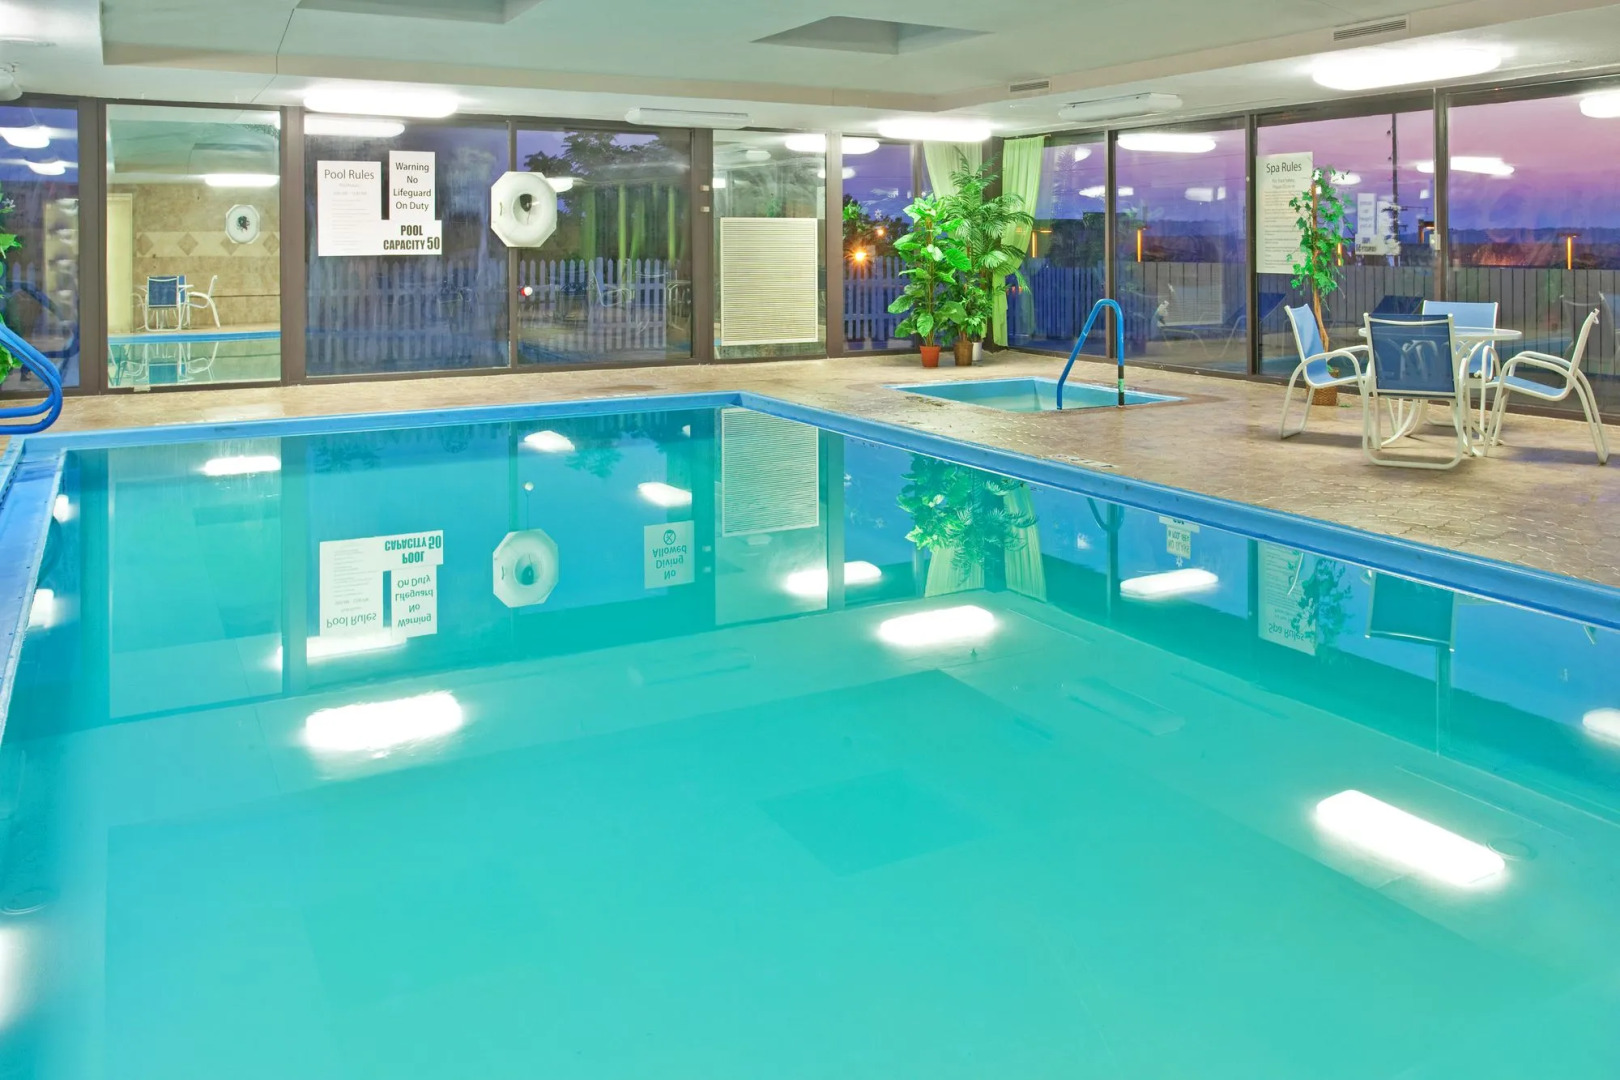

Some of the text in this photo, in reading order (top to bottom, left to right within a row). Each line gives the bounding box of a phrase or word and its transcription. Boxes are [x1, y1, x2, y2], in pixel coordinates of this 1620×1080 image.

[395, 162, 430, 173] Warning
[1266, 161, 1302, 175] Spa Rules
[324, 169, 375, 180] Pool Rules
[406, 175, 419, 184] No
[393, 188, 432, 198] Lifeguard
[395, 201, 429, 211] On Duty
[400, 225, 423, 236] POOL
[383, 236, 440, 250] CAPACITY 50
